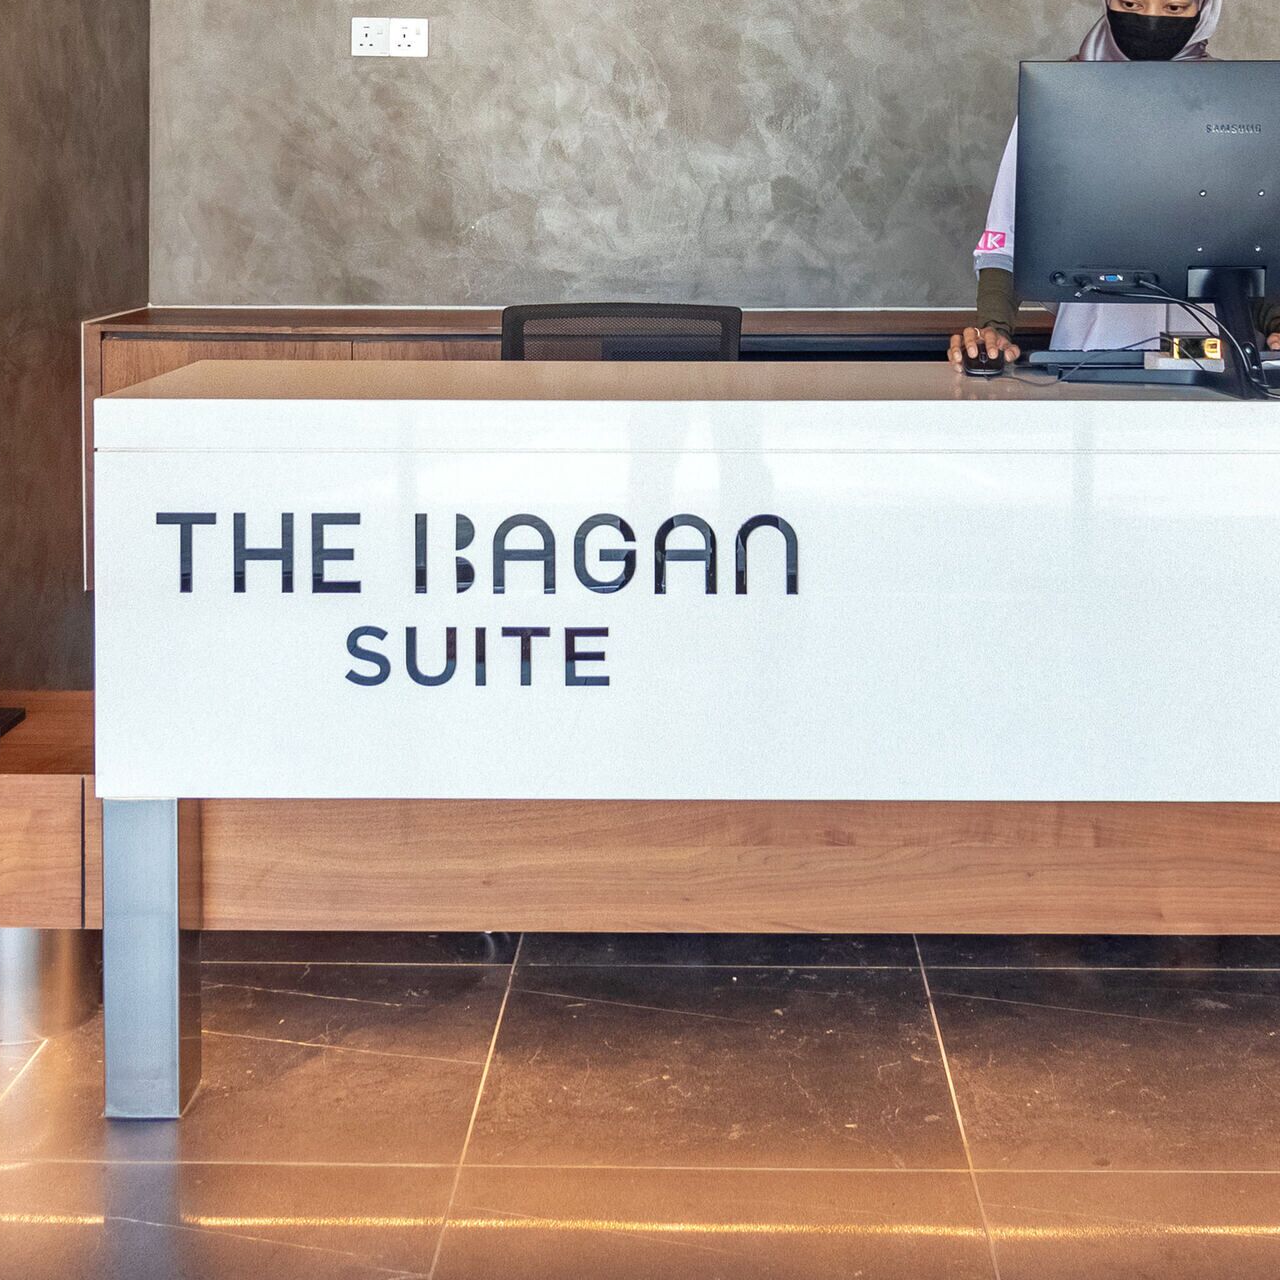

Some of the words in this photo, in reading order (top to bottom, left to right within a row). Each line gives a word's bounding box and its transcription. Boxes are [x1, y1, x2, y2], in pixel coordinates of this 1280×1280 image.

[1205, 123, 1262, 134] SAMSUNG
[156, 513, 361, 593] THE
[346, 626, 609, 686] SUITE
